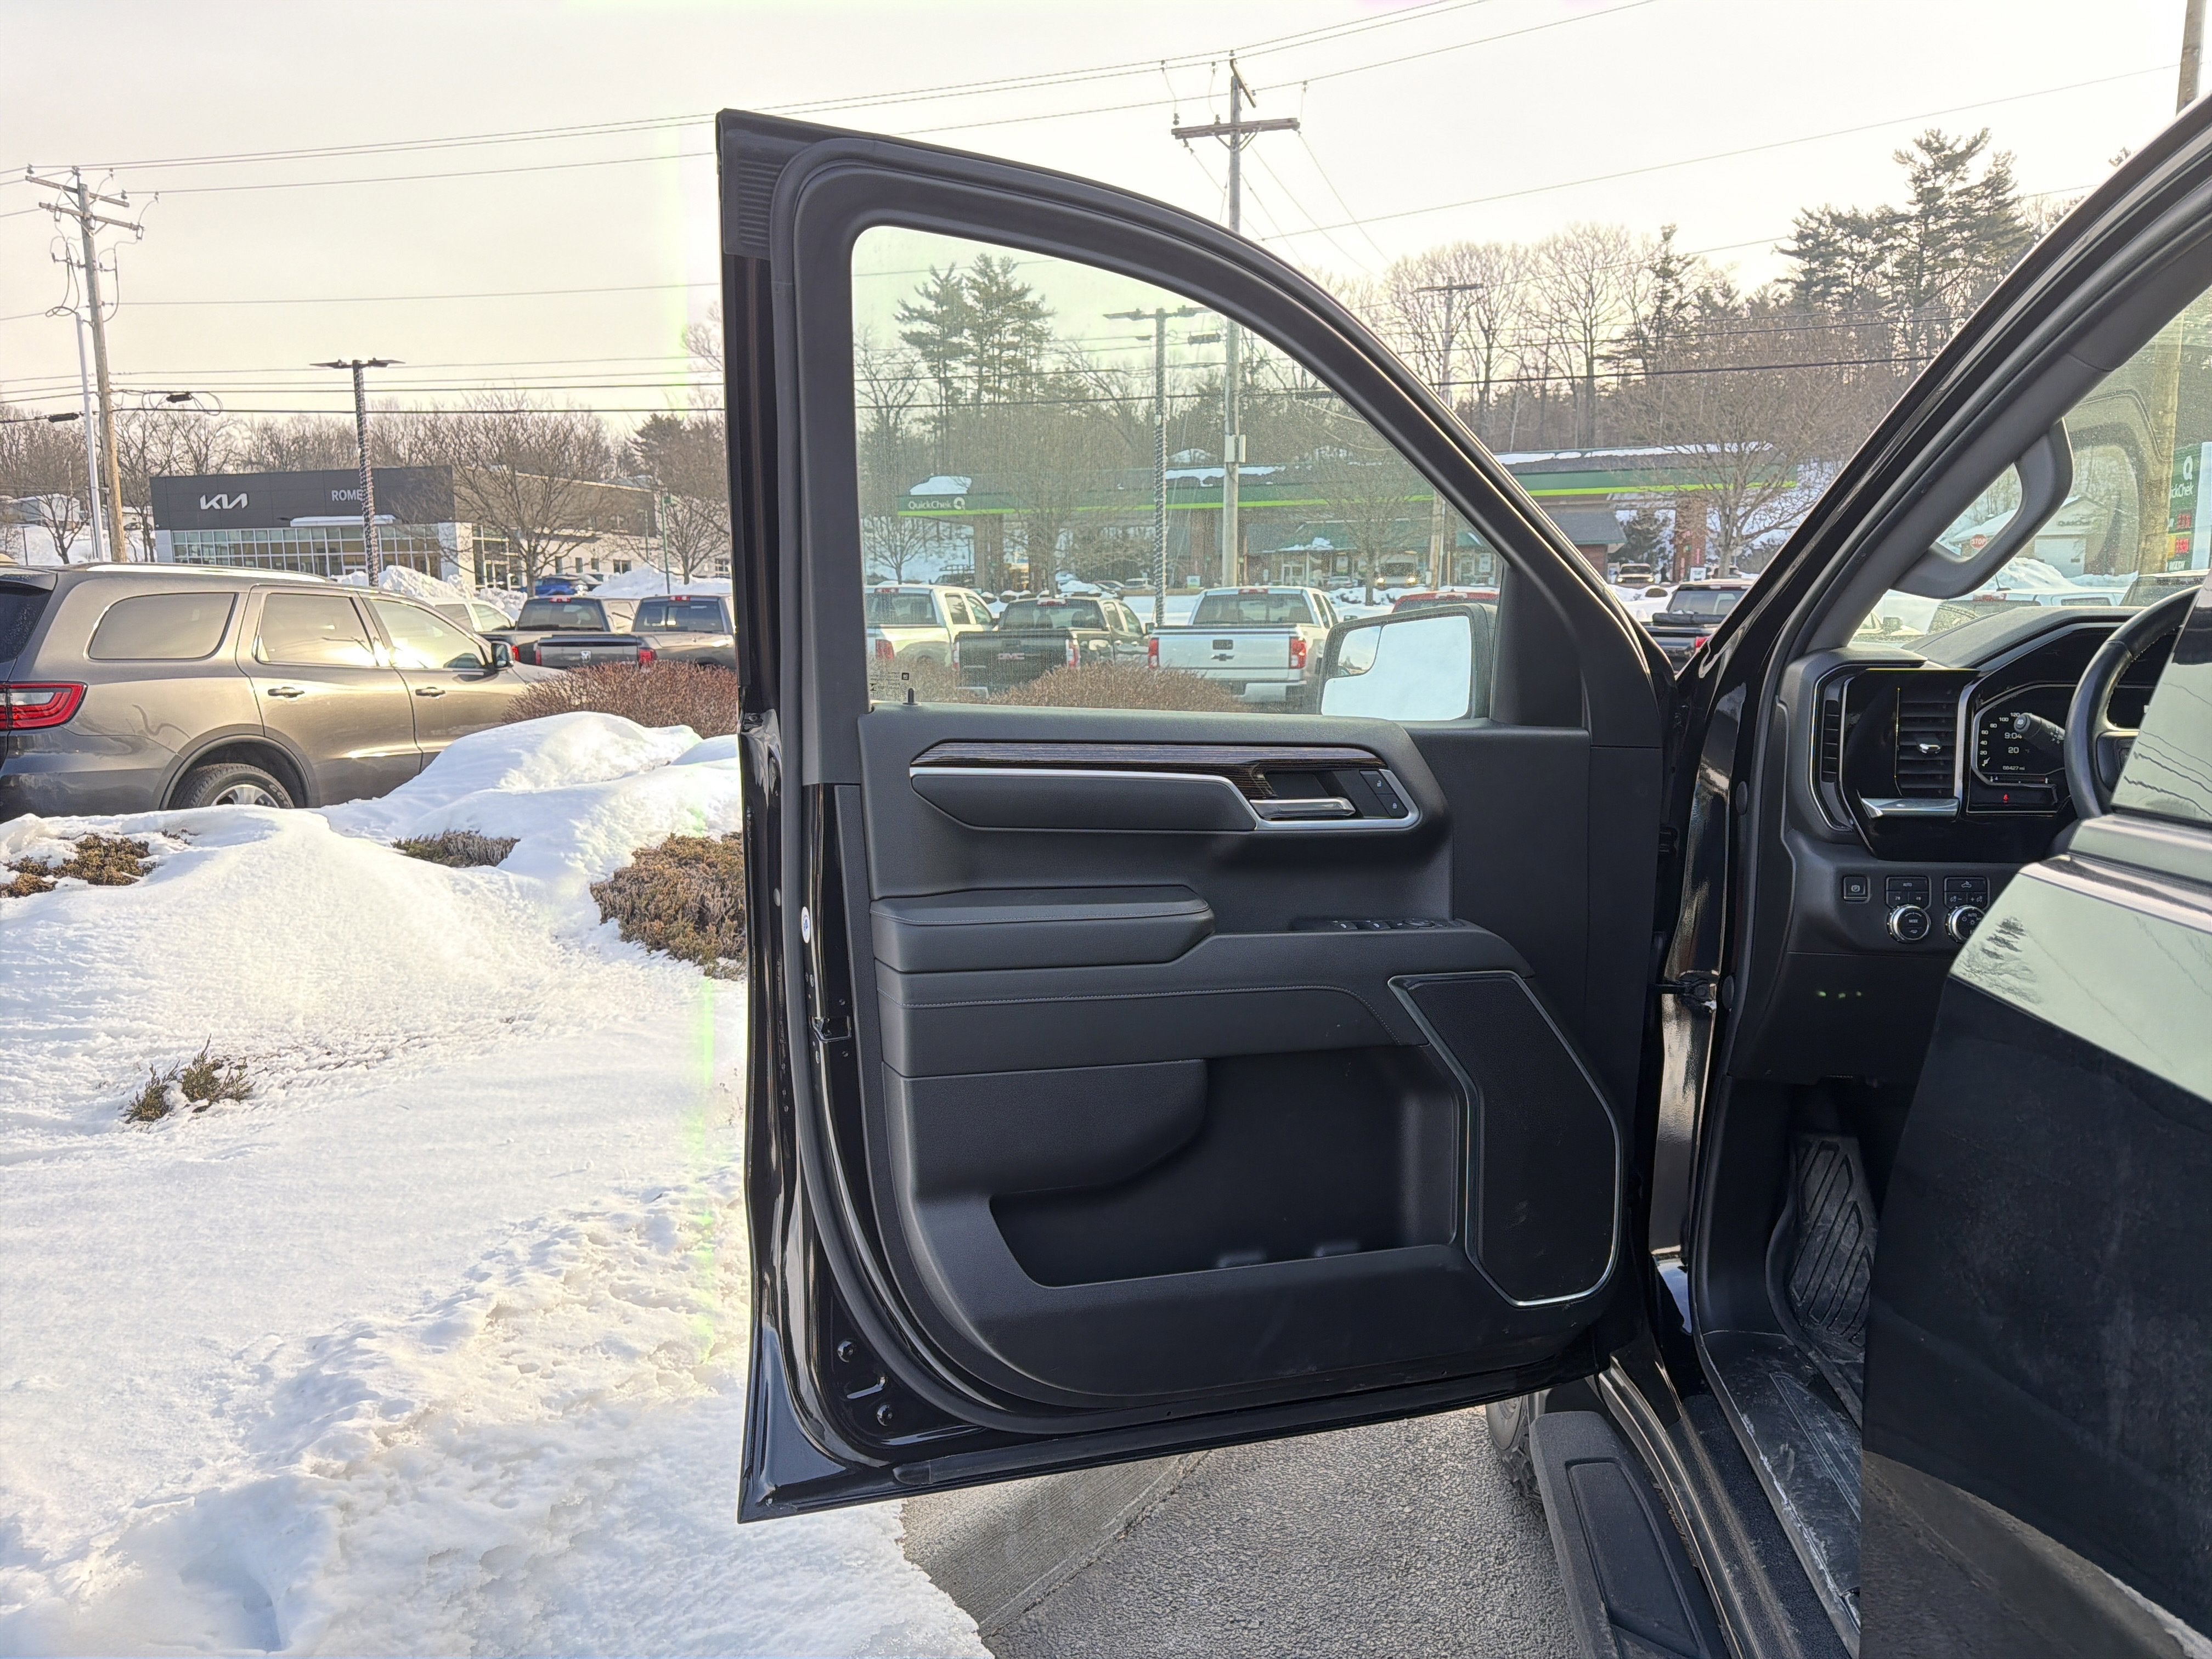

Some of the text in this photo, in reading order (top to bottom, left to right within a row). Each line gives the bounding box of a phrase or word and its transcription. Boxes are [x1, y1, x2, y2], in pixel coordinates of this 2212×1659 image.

[200, 493, 248, 510] KIA
[331, 489, 363, 502] ROME
[908, 500, 952, 510] QuickChek
[1971, 537, 1987, 545] STOP
[268, 783, 291, 808] GOO
